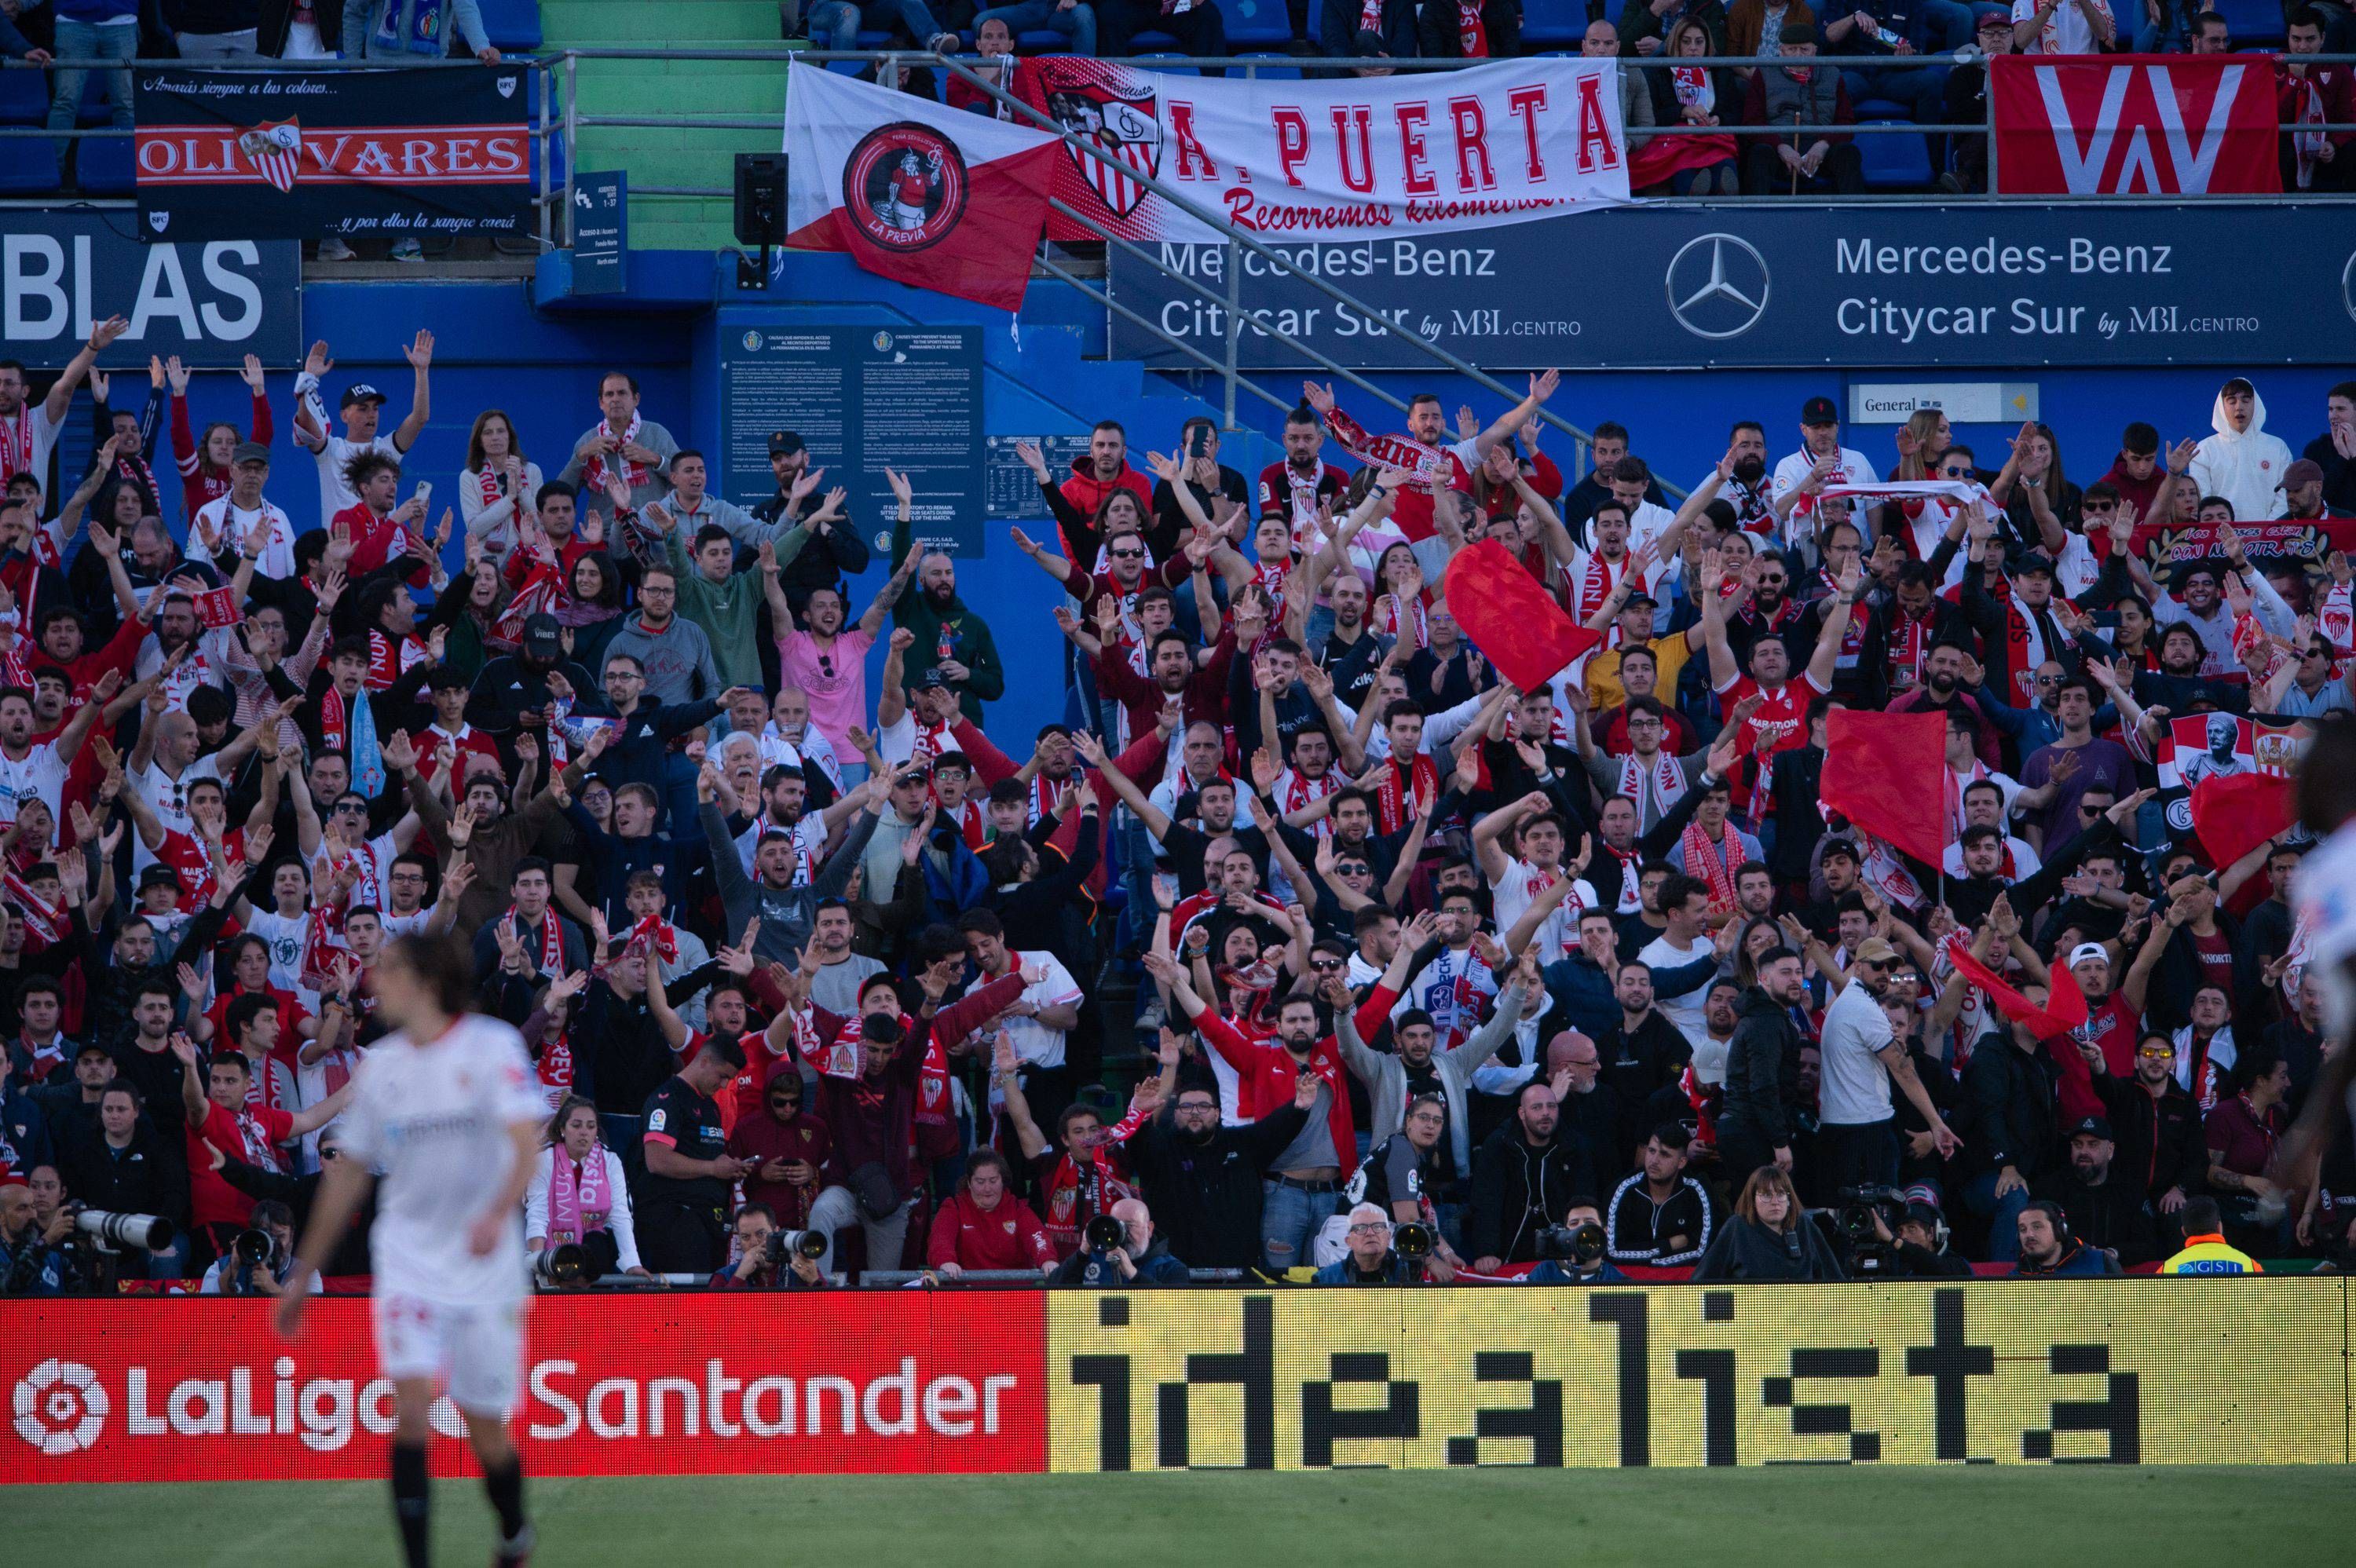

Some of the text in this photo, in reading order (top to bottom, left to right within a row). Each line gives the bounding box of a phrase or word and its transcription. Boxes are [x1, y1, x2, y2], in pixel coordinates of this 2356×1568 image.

[198, 81, 246, 99] siempre
[250, 84, 260, 95] a
[263, 81, 282, 95] tus
[1270, 72, 1619, 197] PUERTA
[382, 214, 411, 229] ellos
[413, 214, 427, 229] la
[431, 217, 475, 234] sangre
[1223, 187, 1394, 232] Recorremos
[868, 220, 927, 244] LA PREVIA
[1161, 240, 1496, 276] Mecedes-Benz
[1836, 237, 2172, 274] Mercedes-Benz
[1334, 301, 1410, 336] Sur
[1420, 316, 1442, 343] by
[1512, 320, 1582, 336] CENTRO
[1836, 298, 1996, 343] Citycar
[2010, 298, 2086, 334] Sur
[2098, 313, 2120, 340] by
[2190, 317, 2260, 333] CENTRO
[1865, 397, 1916, 411] General
[2170, 543, 2204, 561] CON
[1071, 1288, 2140, 1471] idealista
[529, 1357, 1019, 1440] Santander
